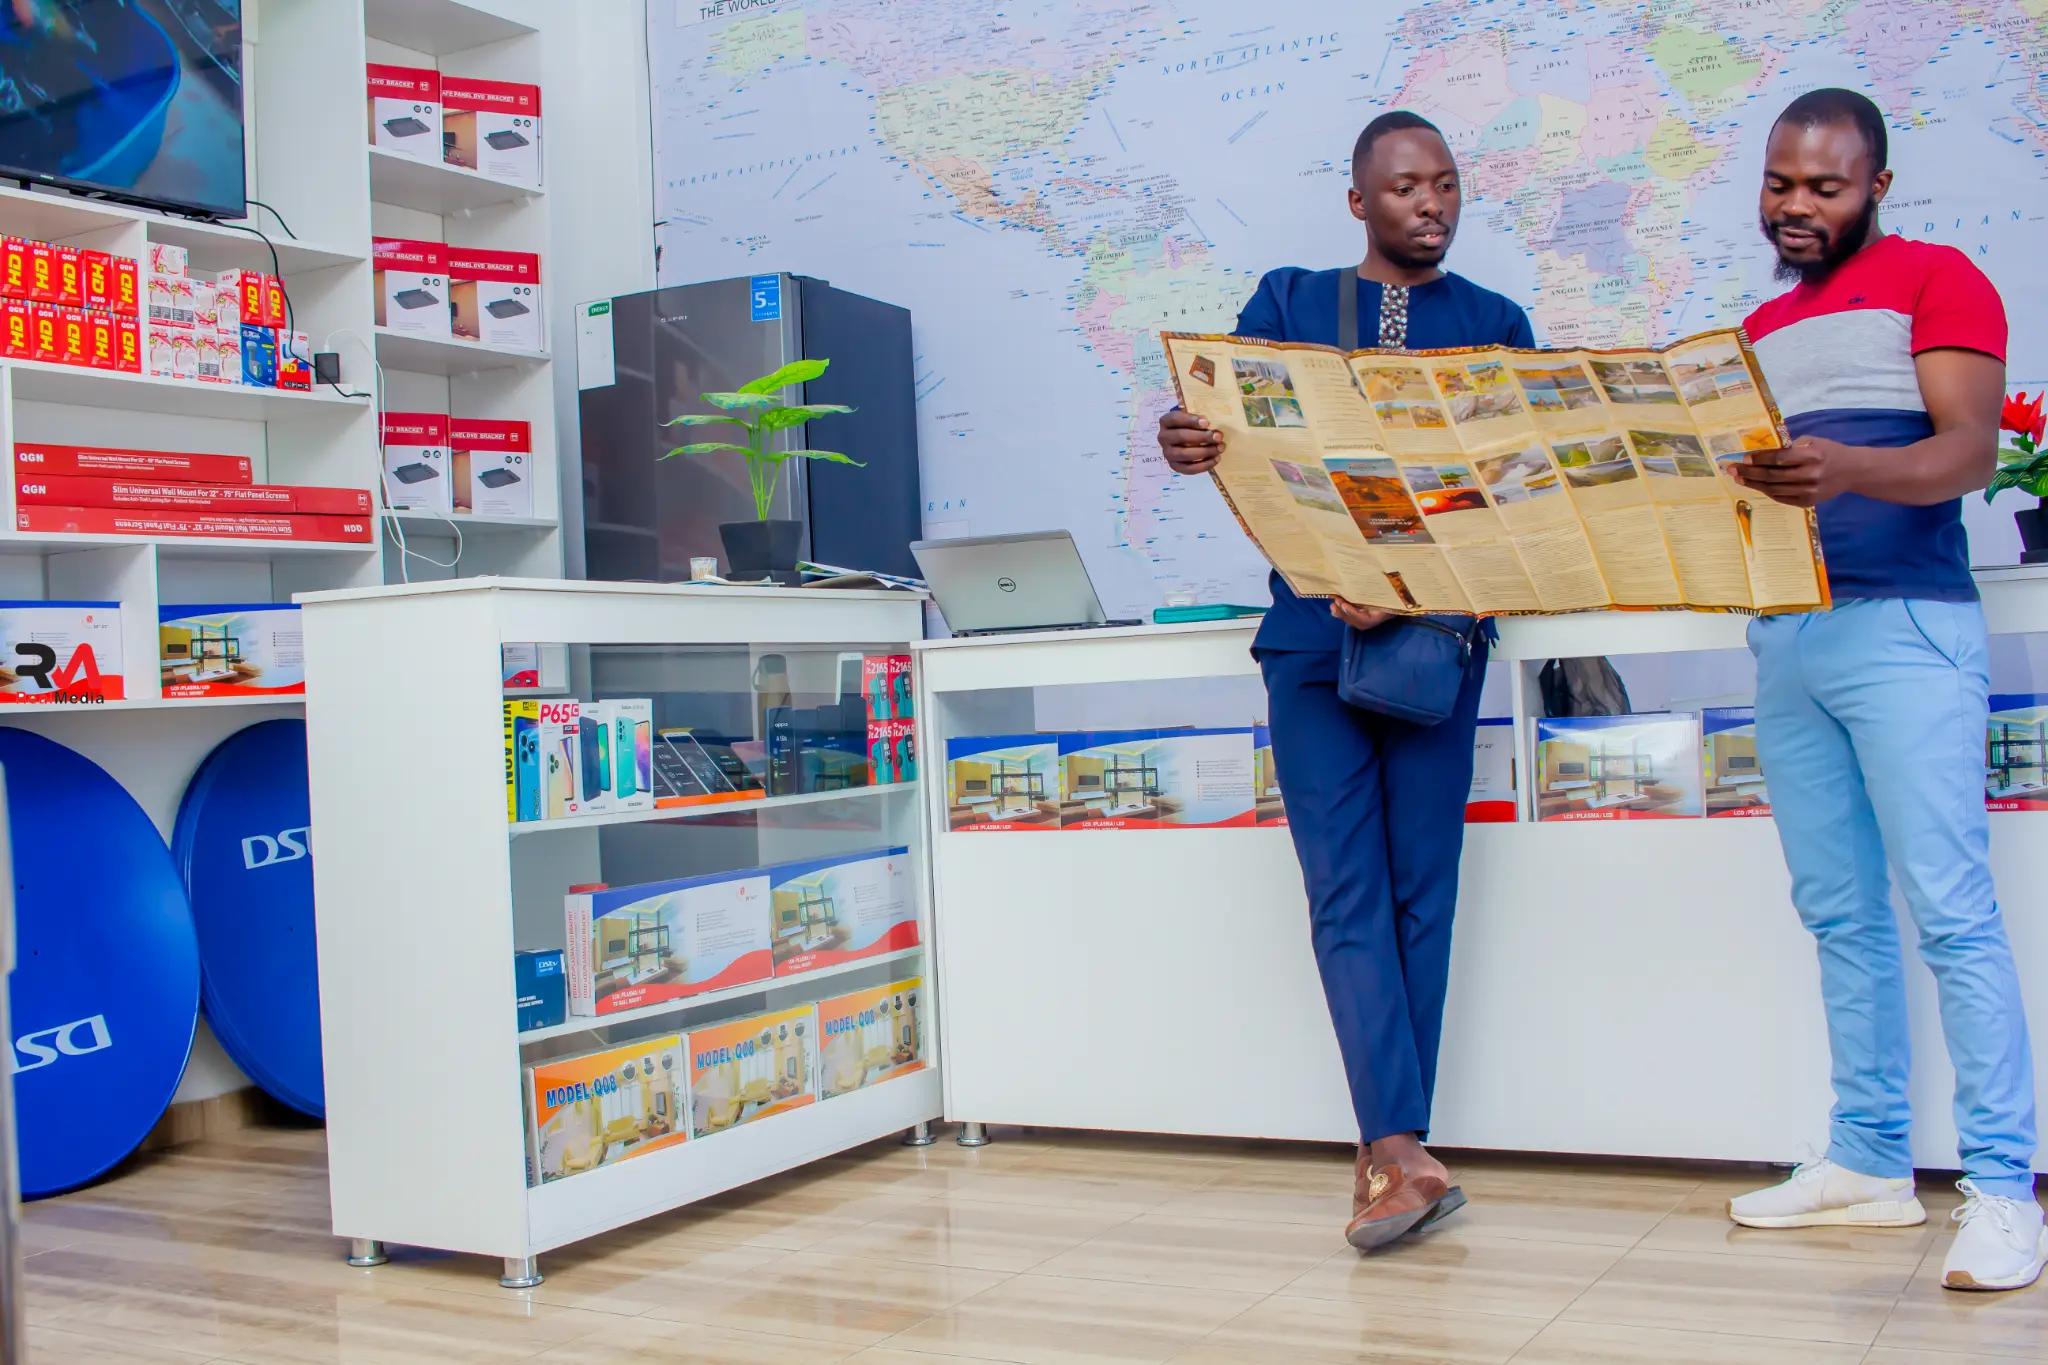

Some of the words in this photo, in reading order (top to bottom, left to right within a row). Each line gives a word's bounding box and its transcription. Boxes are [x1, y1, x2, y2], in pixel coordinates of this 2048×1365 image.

[700, 4, 724, 19] THE
[1865, 20, 1942, 38] INDIA
[1162, 55, 1224, 76] NORTH
[1240, 32, 1338, 60] ATLANTIC
[1536, 60, 1570, 70] LIBYA
[1686, 64, 1722, 74] ARABIA
[386, 80, 414, 88] BRACKET
[1446, 72, 1482, 83] ALGERIA
[487, 94, 514, 102] BRACKET
[1222, 82, 1285, 102] OCEAN
[1494, 121, 1528, 132] NIGER
[1547, 130, 1570, 138] CHAD
[1663, 150, 1698, 159] ETHIOPIA
[669, 172, 718, 188] NORTH
[728, 158, 796, 178] PACIFIC
[806, 146, 859, 162] OCEAN
[1489, 161, 1519, 170] NIGERIA
[1636, 224, 1673, 234] TANZANIA
[1896, 210, 2021, 235] NDIAN
[1119, 234, 1158, 244] VENEZUELA
[8, 244, 23, 252] QGN
[34, 248, 48, 256] QGN
[396, 254, 424, 262] BRACKET
[1091, 252, 1124, 261] COLOMBIA
[8, 254, 22, 286] HD
[36, 258, 48, 290] HD
[64, 263, 76, 294] HD
[92, 263, 104, 294] HD
[1594, 278, 1630, 290] ZAMBIA
[121, 273, 132, 304] HD
[1551, 286, 1584, 296] ANGOLA
[248, 286, 258, 314] HD
[270, 289, 281, 318] HD
[755, 292, 766, 308] 5
[1164, 300, 1240, 318] BRAZI
[10, 316, 24, 348] HD
[1548, 322, 1580, 333] NAMIBIA
[40, 320, 54, 352] HD
[68, 324, 80, 354] HD
[96, 328, 108, 358] HD
[123, 332, 135, 362] HD
[20, 452, 44, 462] QGN
[22, 484, 46, 494] QGN
[868, 726, 892, 739] it2165
[539, 960, 558, 968] DStv
[697, 1040, 755, 1070] MODEL:Q08
[546, 1074, 617, 1108] MODEL:Q08
